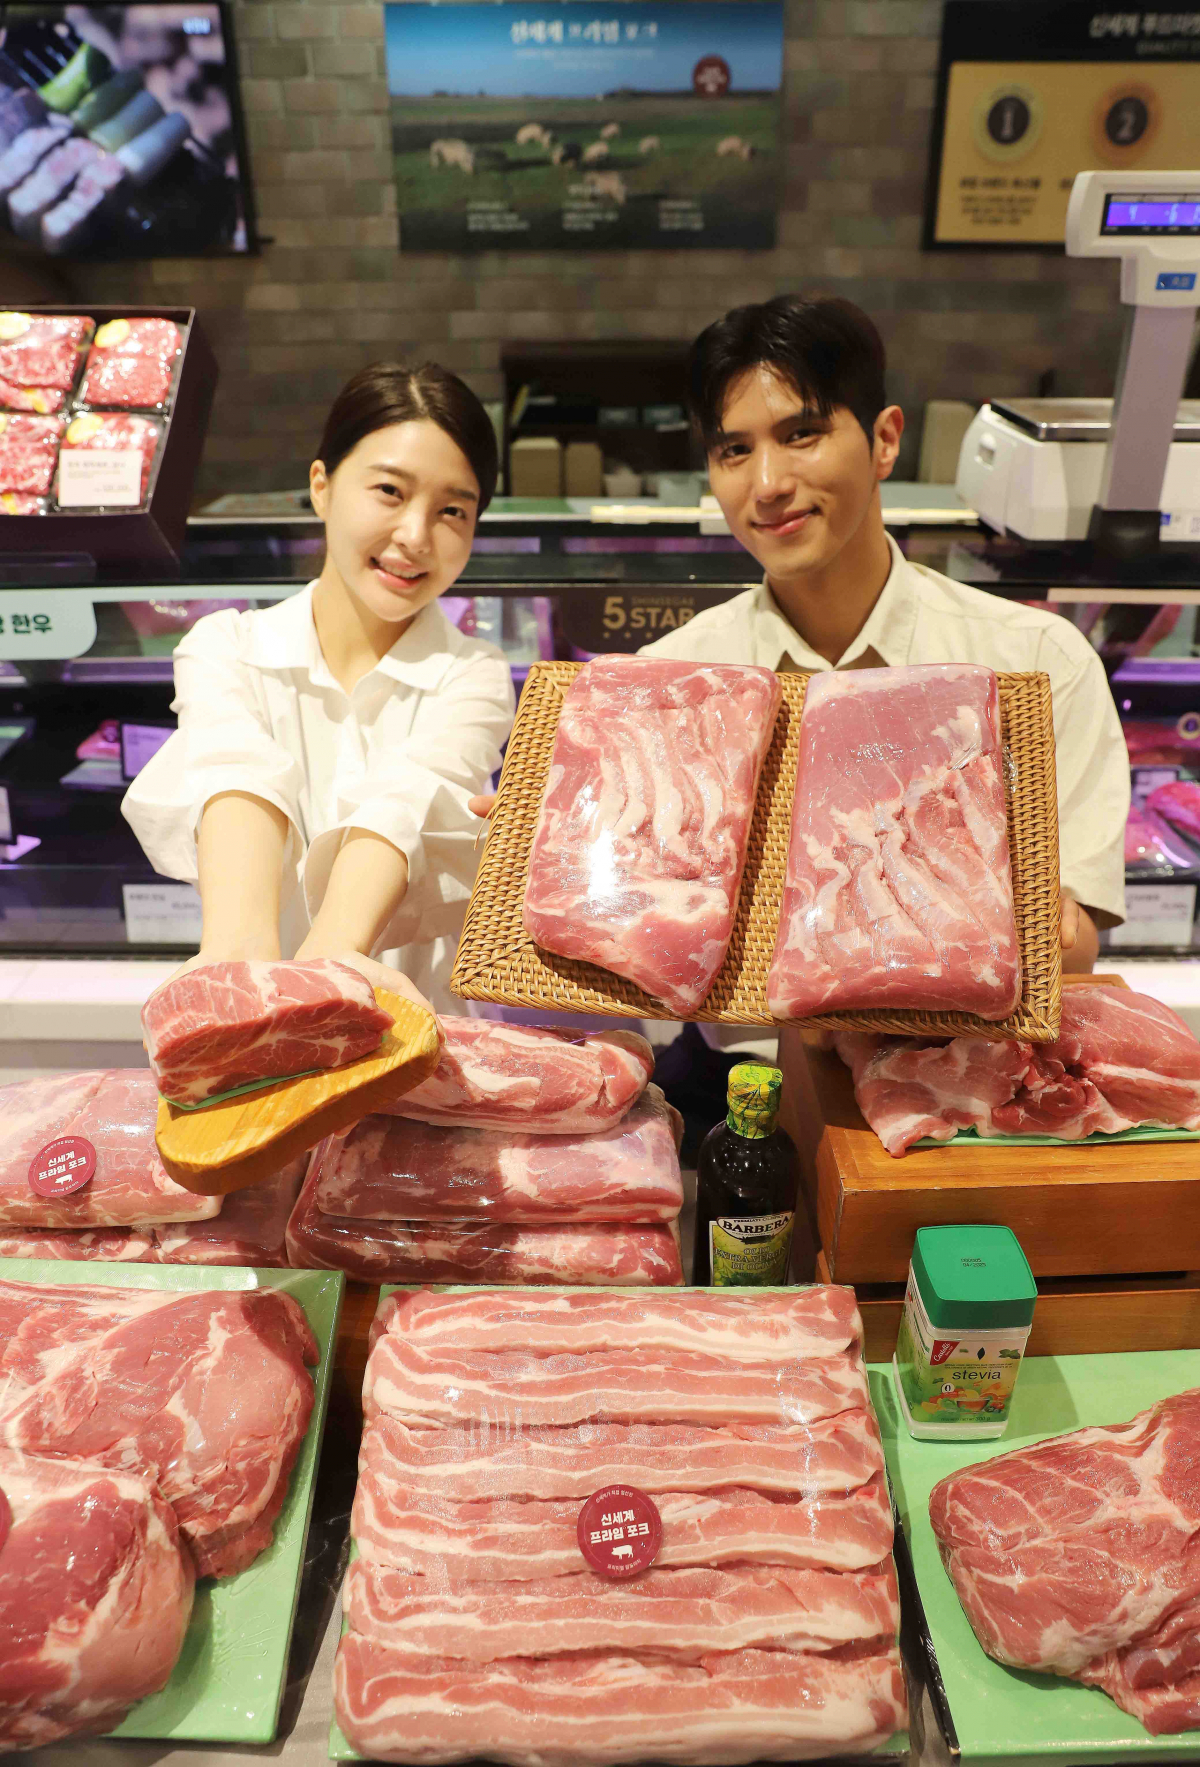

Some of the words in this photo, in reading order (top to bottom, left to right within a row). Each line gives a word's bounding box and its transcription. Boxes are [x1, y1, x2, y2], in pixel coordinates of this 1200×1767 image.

[1117, 109, 1135, 140] 2
[603, 596, 627, 630] 5
[11, 614, 53, 634] 한우
[38, 1165, 66, 1181] 프라임
[68, 1157, 87, 1169] 포크
[48, 1150, 75, 1168] 신세계
[723, 1216, 789, 1233] BARBERA
[952, 1369, 1001, 1380] stevia
[601, 1509, 636, 1526] 신세계
[590, 1526, 624, 1544] 프라임
[627, 1522, 650, 1538] 포크
